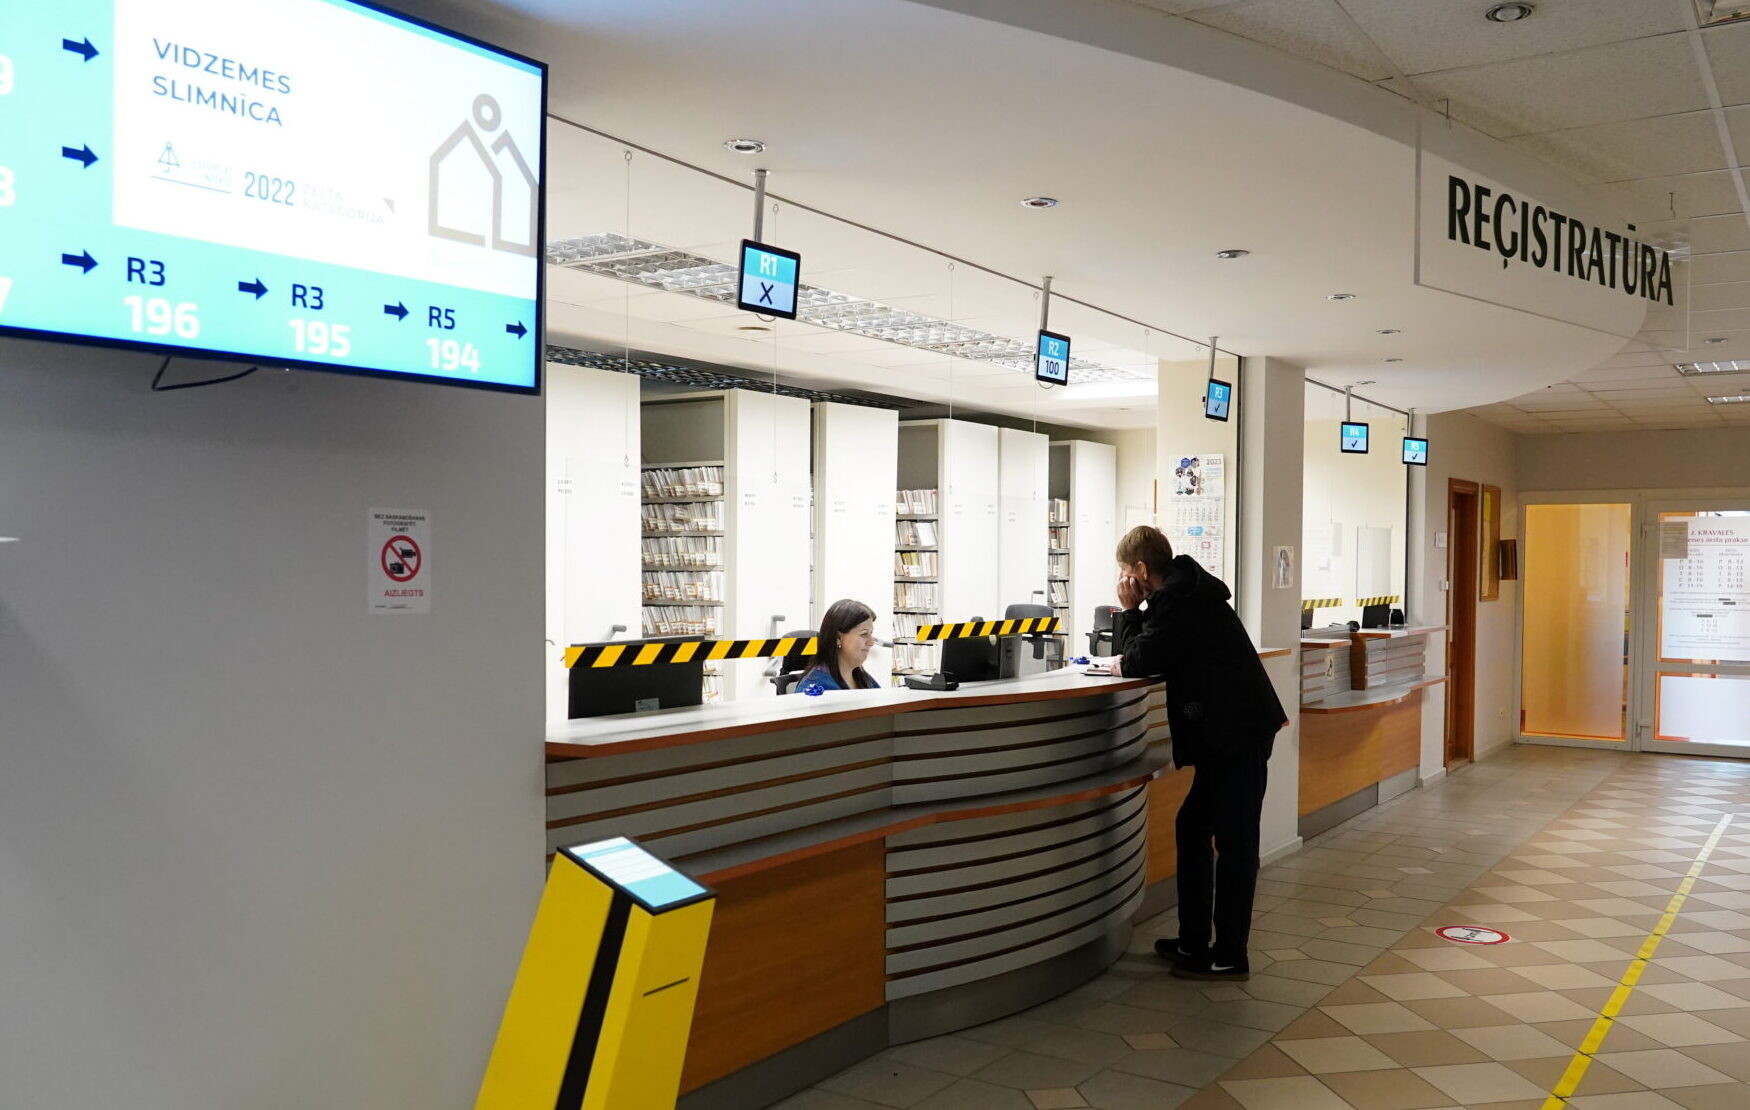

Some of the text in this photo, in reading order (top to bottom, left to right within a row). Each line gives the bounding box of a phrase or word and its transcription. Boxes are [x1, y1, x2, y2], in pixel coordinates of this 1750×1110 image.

[152, 37, 292, 95] VIDZEMES
[151, 74, 284, 127] SLIMNĪCA
[244, 171, 296, 206] 2022
[1448, 174, 1674, 306] REĢISTRATŪRA
[126, 256, 167, 288] R3
[760, 253, 778, 277] R1
[291, 283, 325, 311] R3
[122, 295, 201, 339] 196
[428, 306, 456, 330] R5
[288, 318, 351, 358] 195
[1048, 340, 1060, 356] R2
[425, 338, 481, 374] 194
[1045, 360, 1060, 376] 100
[384, 589, 424, 597] AIZLIEGTS
